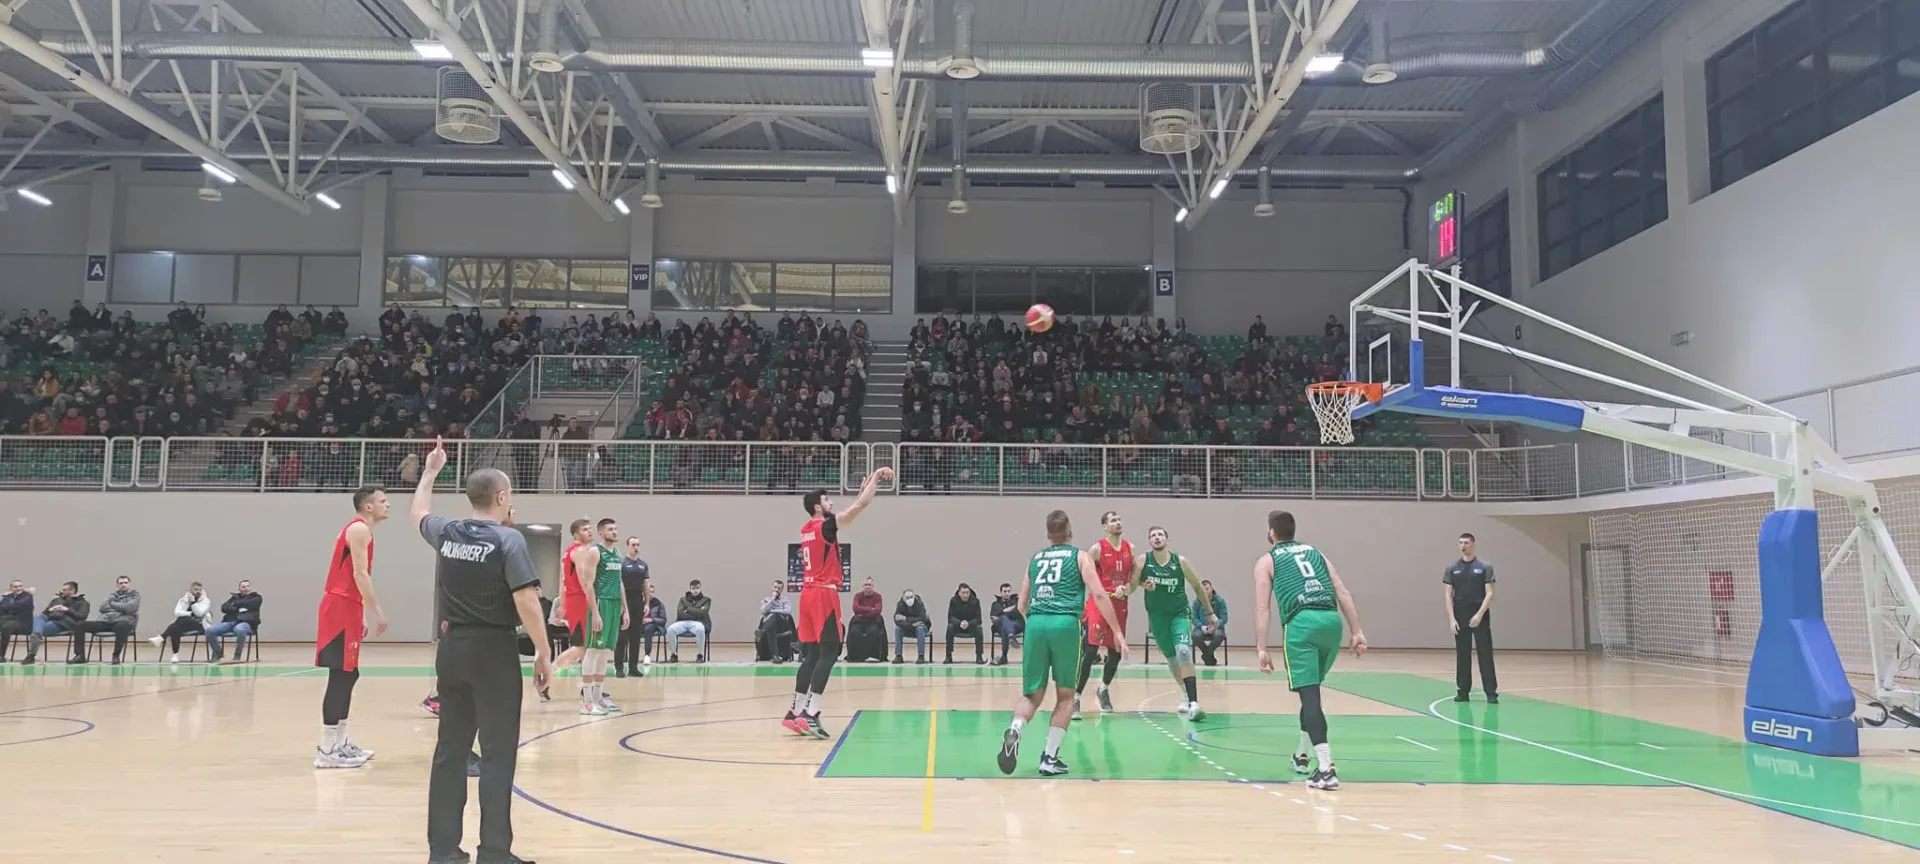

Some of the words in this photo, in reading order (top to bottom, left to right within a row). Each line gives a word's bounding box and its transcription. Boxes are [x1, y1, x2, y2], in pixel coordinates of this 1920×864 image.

[91, 263, 103, 276] A
[1160, 279, 1171, 291] B
[1035, 559, 1063, 584] 23
[1116, 561, 1123, 571] 11
[1294, 554, 1316, 578] 6
[1751, 718, 1813, 743] elan
